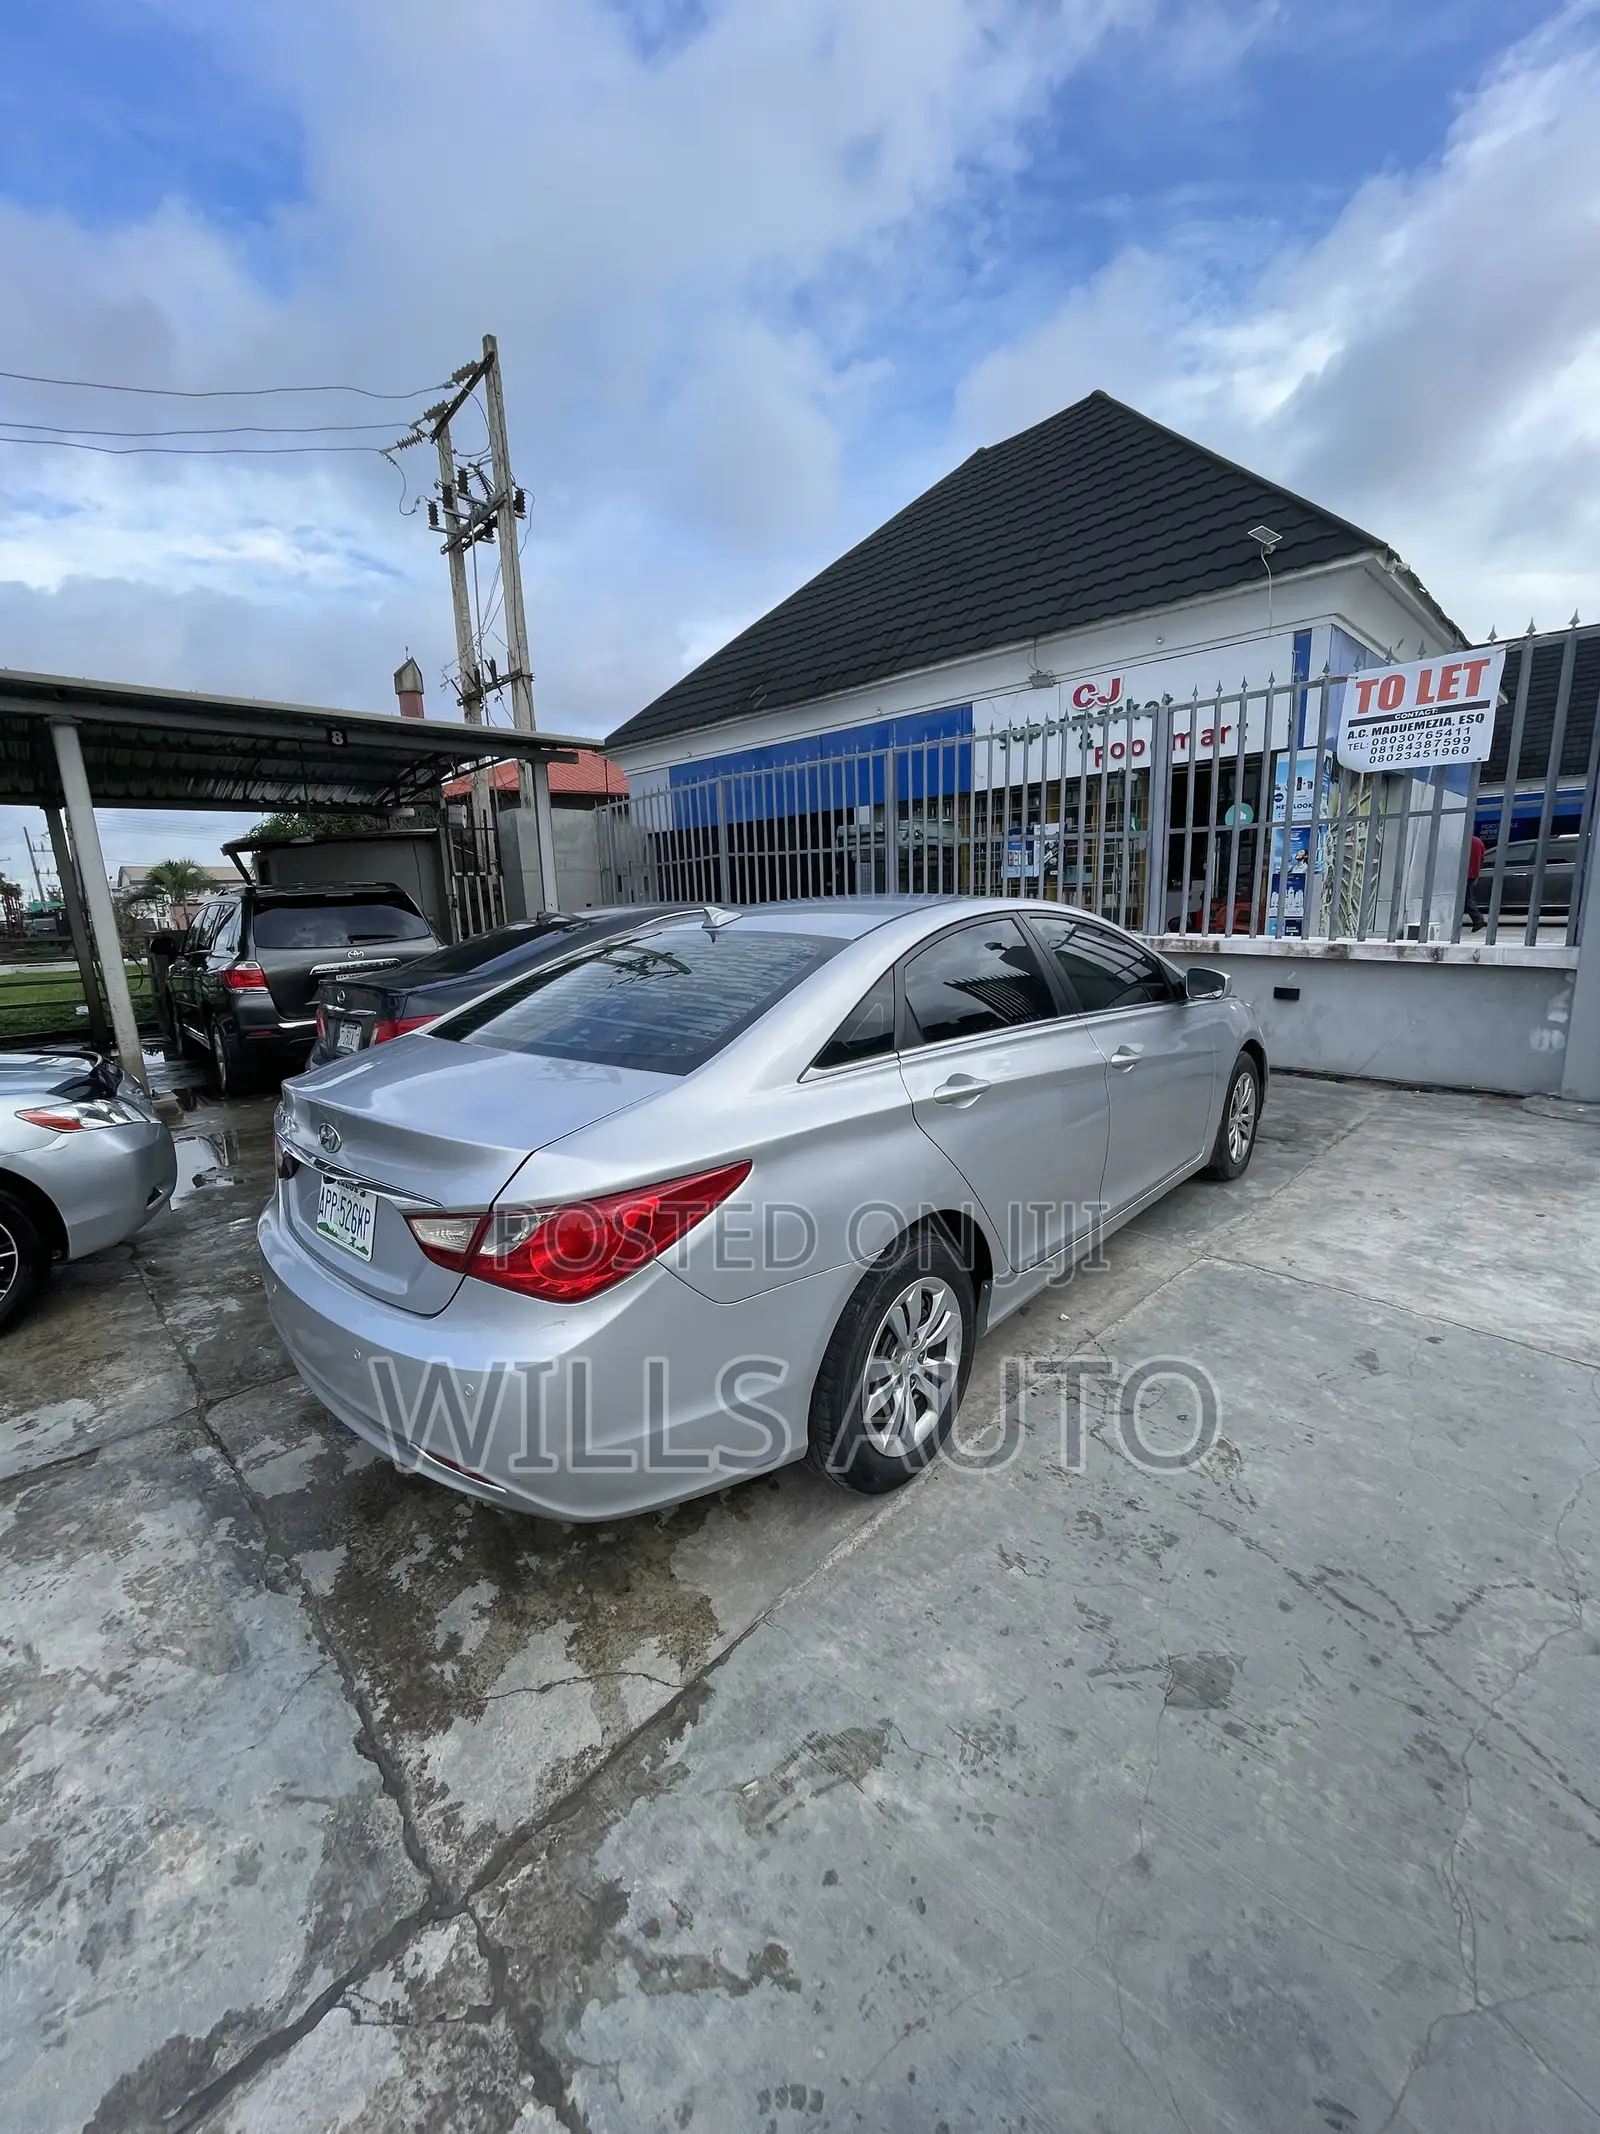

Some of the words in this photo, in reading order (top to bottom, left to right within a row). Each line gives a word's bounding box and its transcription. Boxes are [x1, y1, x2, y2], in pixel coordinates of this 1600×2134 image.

[1072, 677, 1123, 709] CJ
[1355, 674, 1406, 714] TO
[1416, 658, 1491, 706] LET
[1394, 708, 1439, 720] CONTACT:
[1347, 730, 1369, 740] A.C.
[1458, 713, 1485, 725] ESQ
[331, 730, 344, 745] 8
[1348, 742, 1369, 751] TEL:
[1371, 727, 1471, 747] 08030765411
[1370, 736, 1471, 755] 08184387599
[1369, 746, 1470, 764] 08023451960
